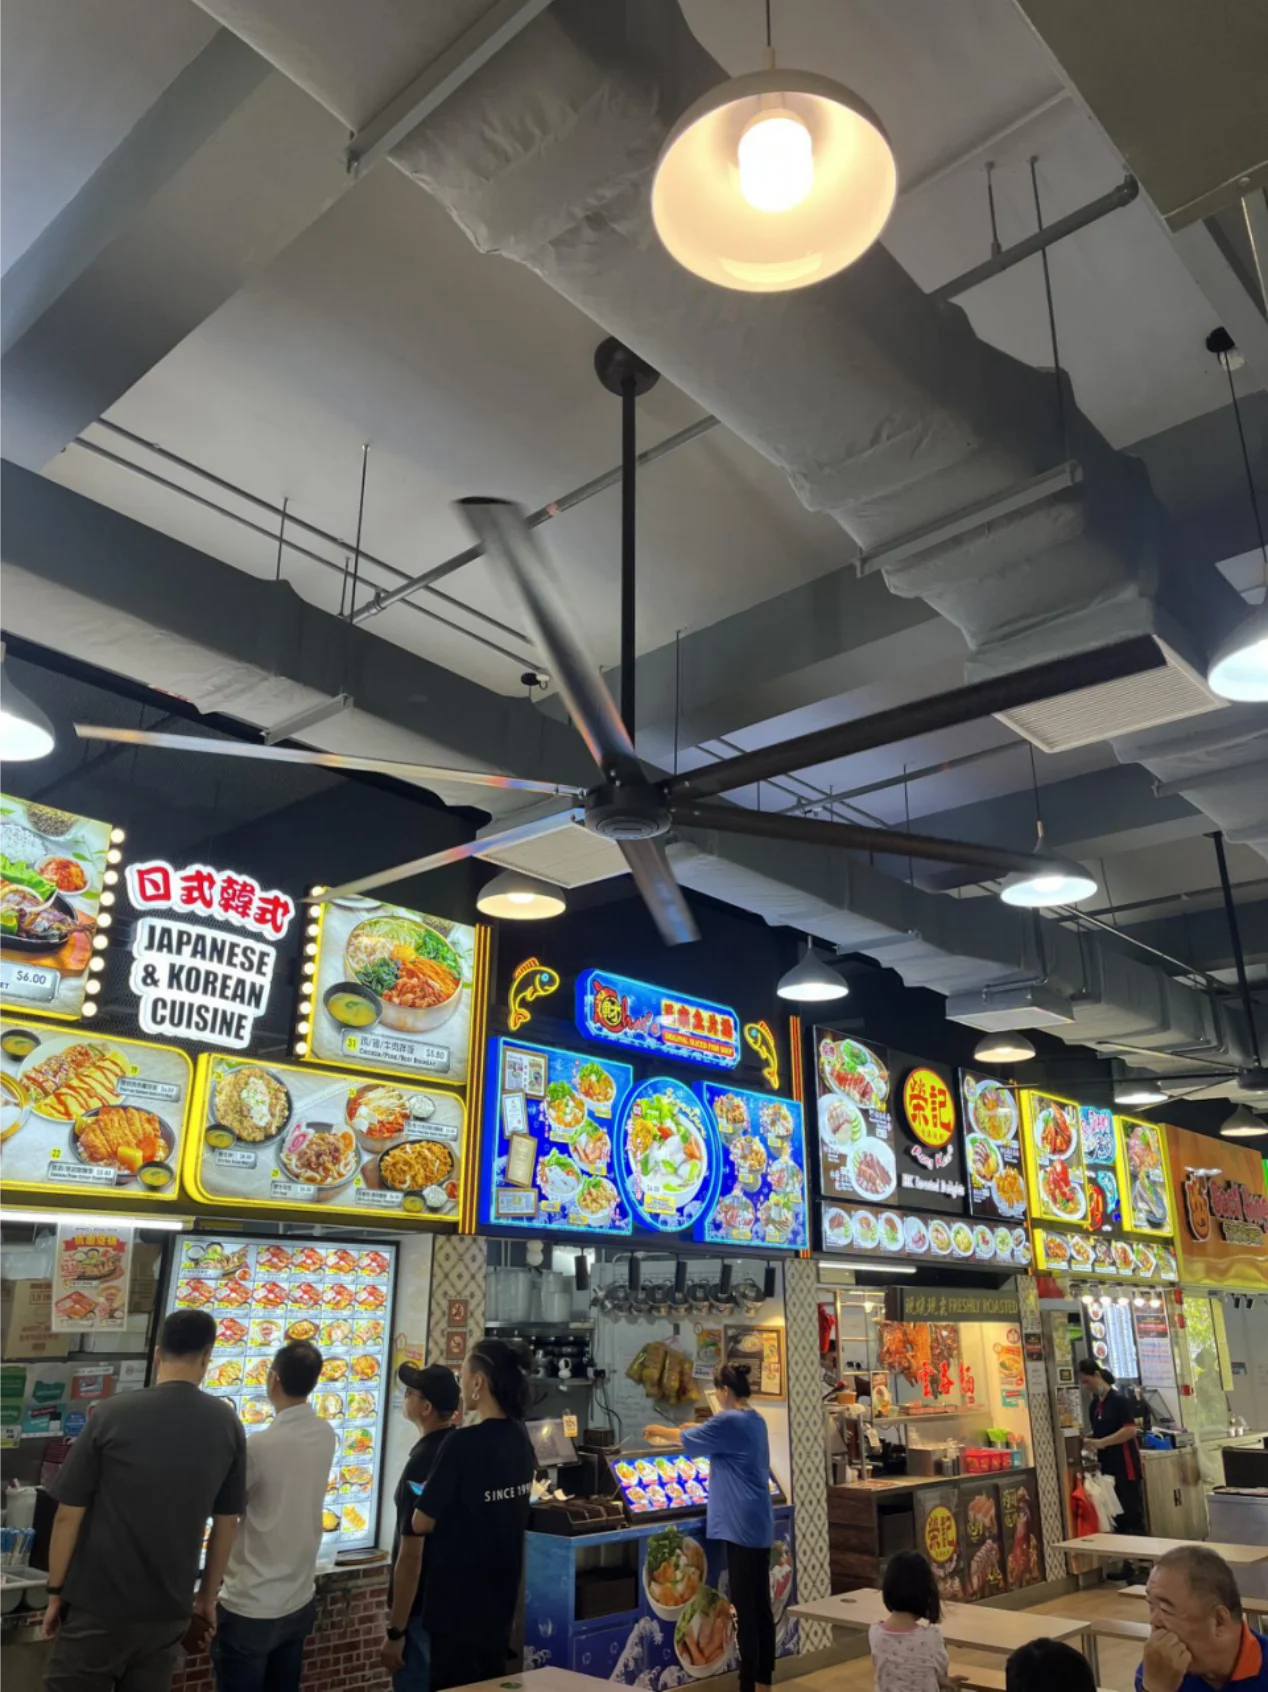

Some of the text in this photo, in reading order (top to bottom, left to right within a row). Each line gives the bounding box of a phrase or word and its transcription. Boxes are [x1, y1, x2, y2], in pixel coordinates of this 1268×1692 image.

[136, 866, 290, 933] 日式韓式
[144, 924, 271, 977] JAPANESE
[16, 970, 46, 985] $6.00
[141, 962, 264, 1010] & KOREAN
[151, 997, 248, 1041] CUISINE
[949, 1298, 980, 1314] FRESHLY
[982, 1299, 1018, 1314] ROASTED
[484, 1487, 515, 1502] SINCE
